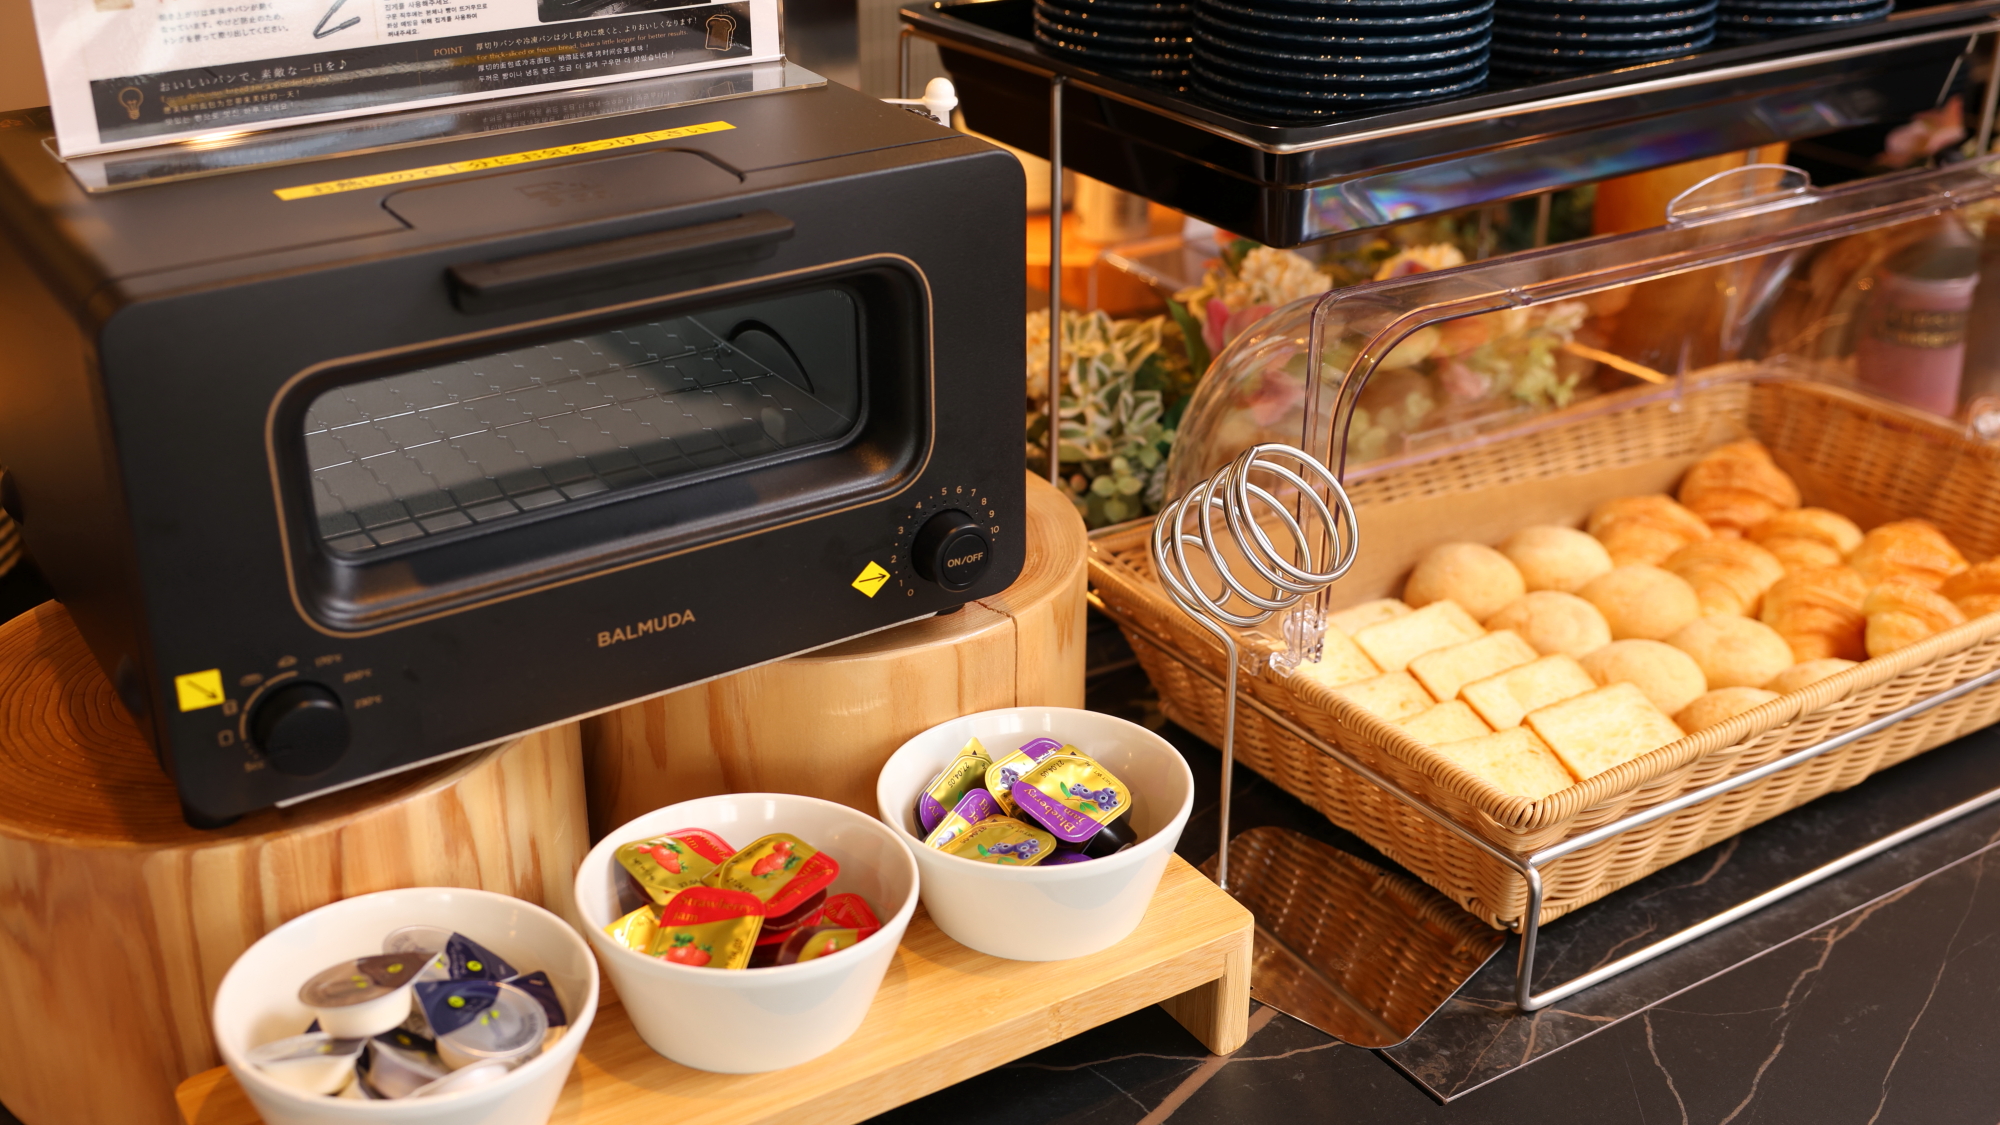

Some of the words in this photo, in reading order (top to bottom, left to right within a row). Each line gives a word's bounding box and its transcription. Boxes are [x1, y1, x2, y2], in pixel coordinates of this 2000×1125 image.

[616, 37, 636, 45] longer
[648, 32, 666, 40] better
[433, 46, 464, 57] POINT
[941, 487, 948, 495] 5
[956, 486, 962, 494] 6
[971, 488, 977, 497] 7
[915, 501, 922, 509] 4
[981, 497, 987, 506] 8
[988, 510, 995, 518] 9
[898, 526, 904, 534] 3
[990, 525, 1000, 534] 10
[891, 555, 897, 563] 2
[947, 552, 984, 568] ON/OFF
[907, 588, 914, 597] 0
[597, 609, 696, 648] BALMUDA
[1040, 759, 1065, 779] 27.04.05
[947, 762, 970, 789] 27.04.05
[1023, 788, 1077, 833] Blueberry
[1063, 807, 1087, 825] jam
